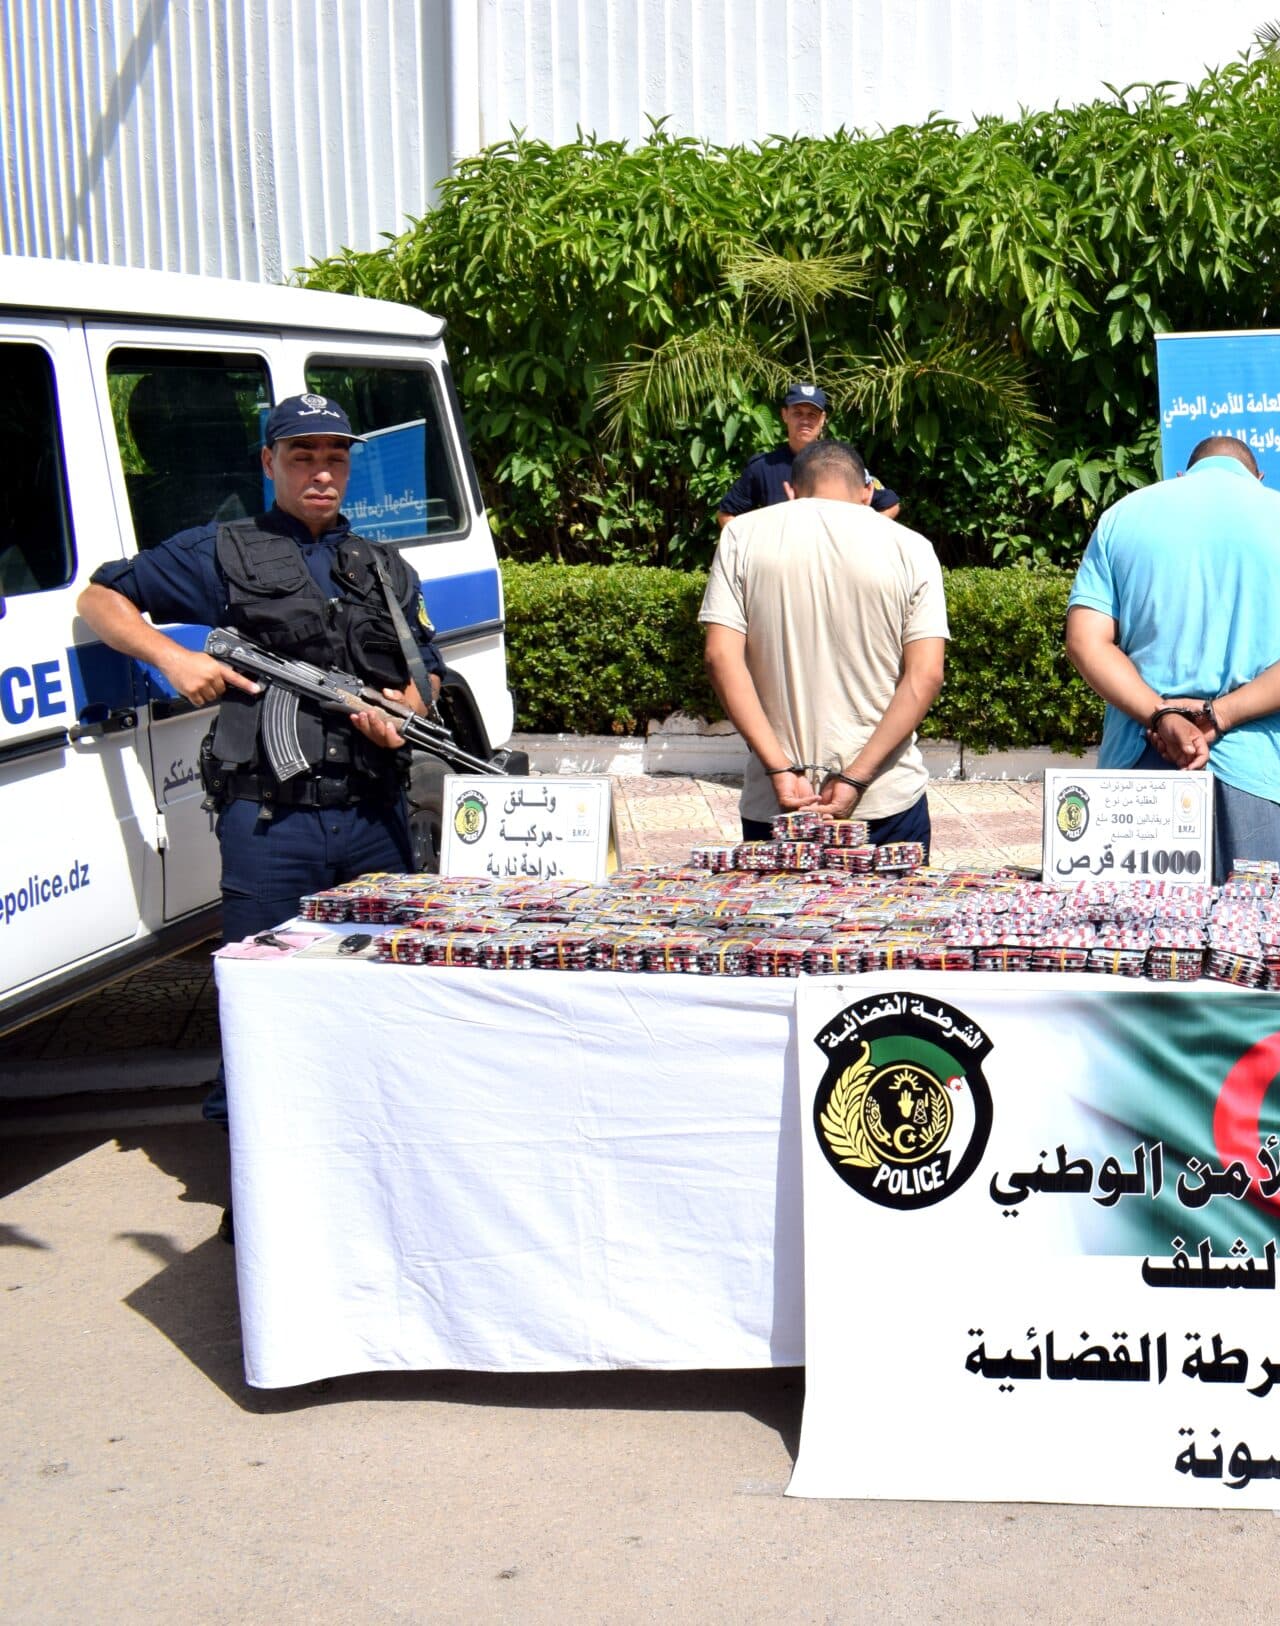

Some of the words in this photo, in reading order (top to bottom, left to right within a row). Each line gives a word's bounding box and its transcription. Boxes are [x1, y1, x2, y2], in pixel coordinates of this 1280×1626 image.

[1163, 395, 1207, 428] الوطني
[1210, 391, 1244, 419] للأمن
[503, 786, 556, 814] وثائق
[1111, 813, 1134, 824] 300
[1056, 843, 1115, 876] قرص
[1120, 849, 1202, 875] 41000
[820, 994, 908, 1049] القضائية
[910, 999, 984, 1050] الشرطة
[872, 1159, 946, 1195] POLICE
[989, 1141, 1164, 1218] الوطني
[964, 1326, 1169, 1394] القضائية
